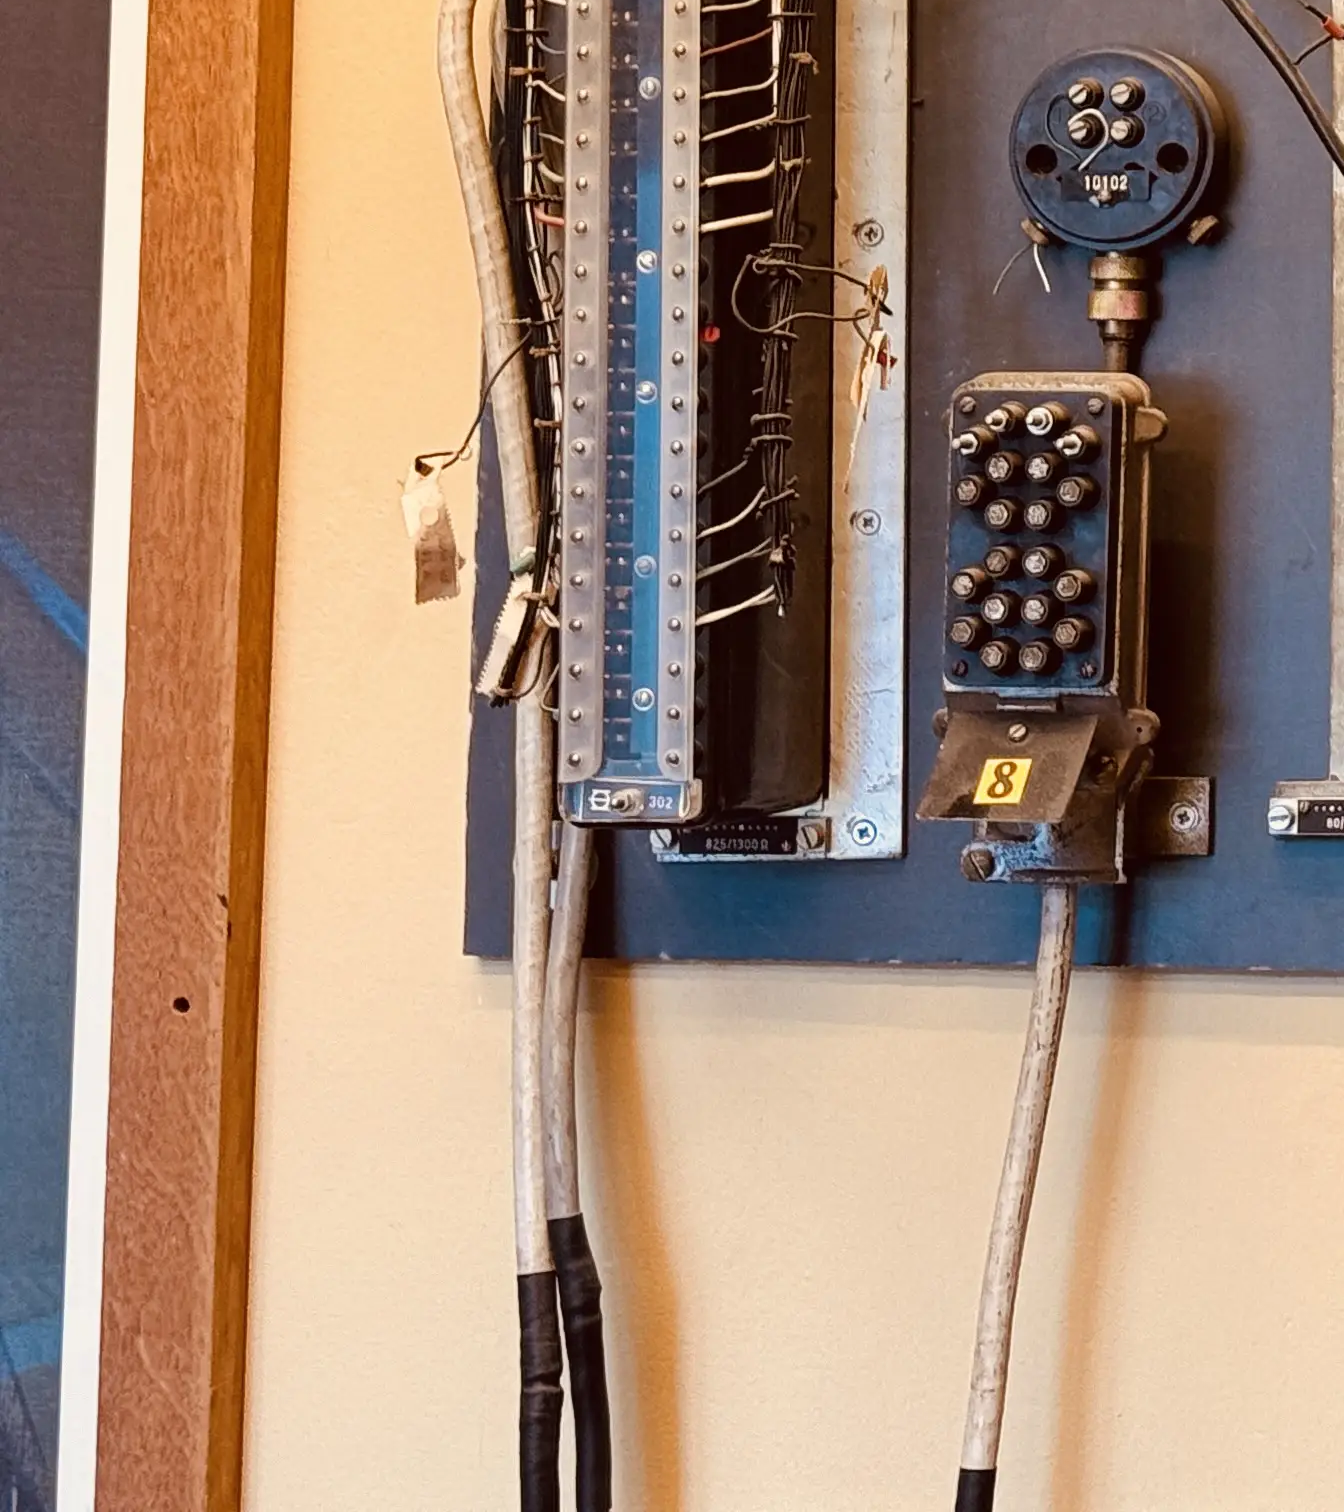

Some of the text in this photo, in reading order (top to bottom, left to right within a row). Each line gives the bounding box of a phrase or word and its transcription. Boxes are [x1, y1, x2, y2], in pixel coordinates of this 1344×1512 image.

[1084, 174, 1128, 192] 10102
[987, 761, 1018, 799] 8
[648, 795, 673, 810] 302
